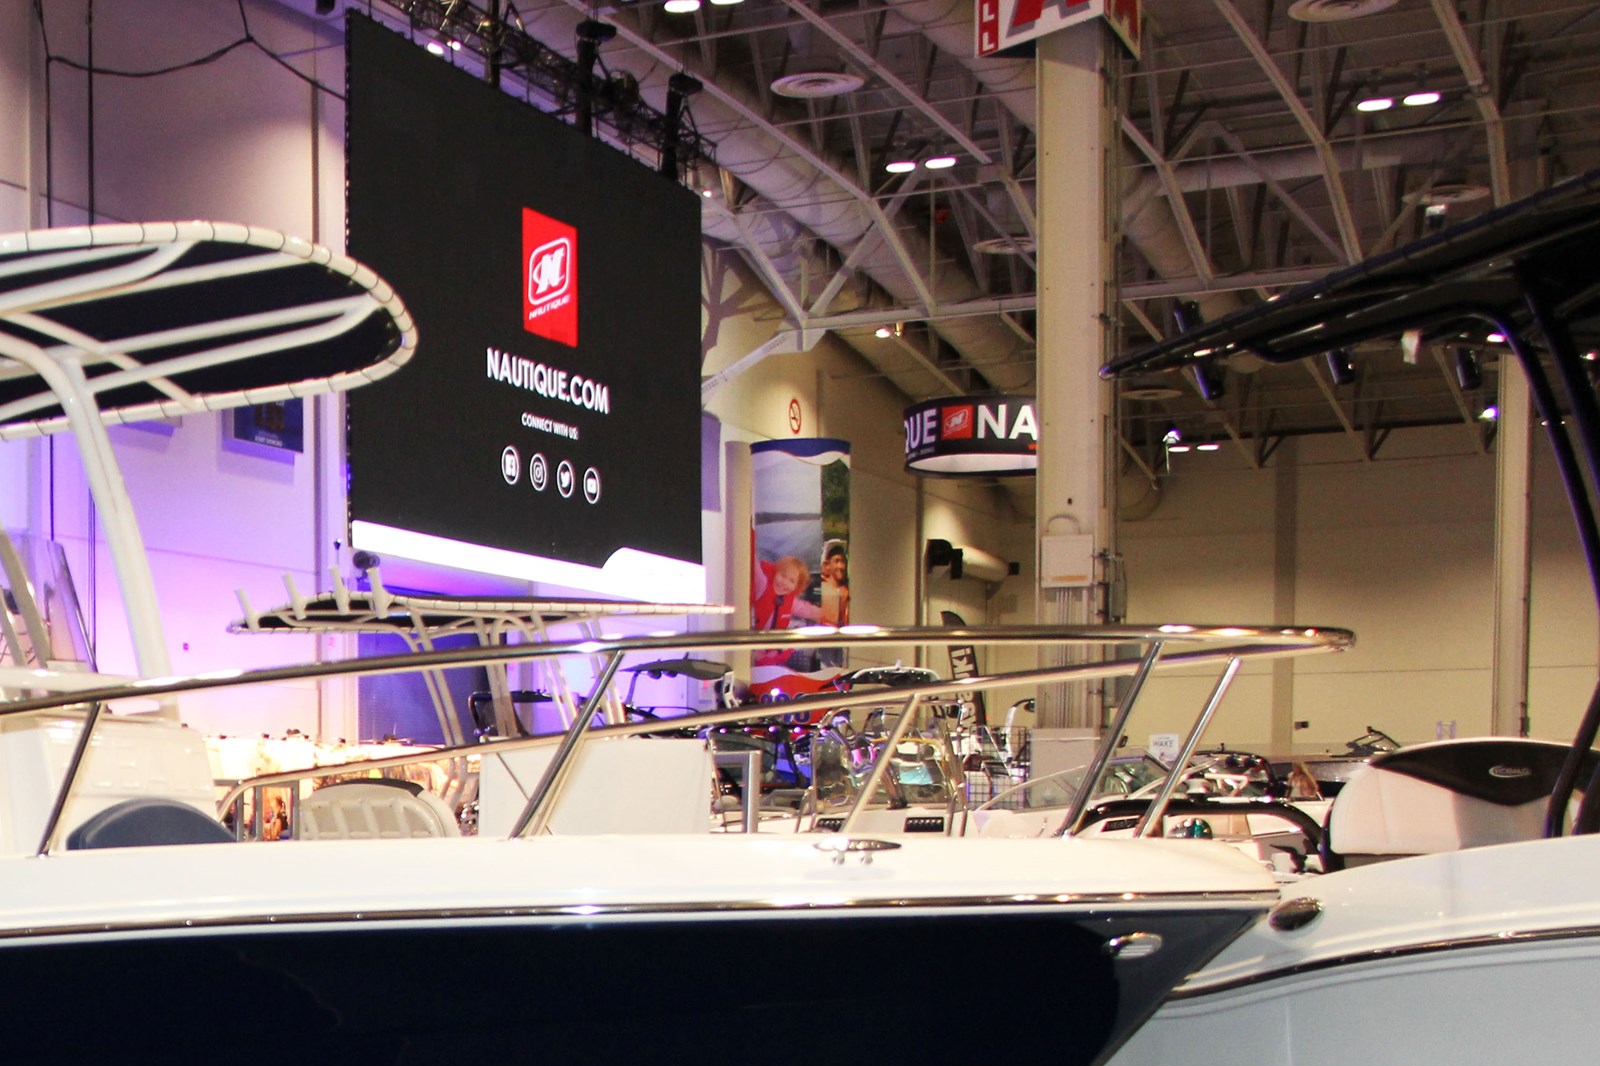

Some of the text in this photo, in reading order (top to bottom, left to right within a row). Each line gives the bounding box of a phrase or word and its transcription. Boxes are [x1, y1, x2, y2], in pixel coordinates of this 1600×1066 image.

[529, 296, 571, 320] NAUTIQUE
[486, 346, 610, 415] NAUTIQUE.COM
[521, 412, 553, 433] CONNECT
[552, 422, 569, 438] WITH
[977, 404, 1038, 441] NA
[1152, 740, 1175, 748] WAKE
